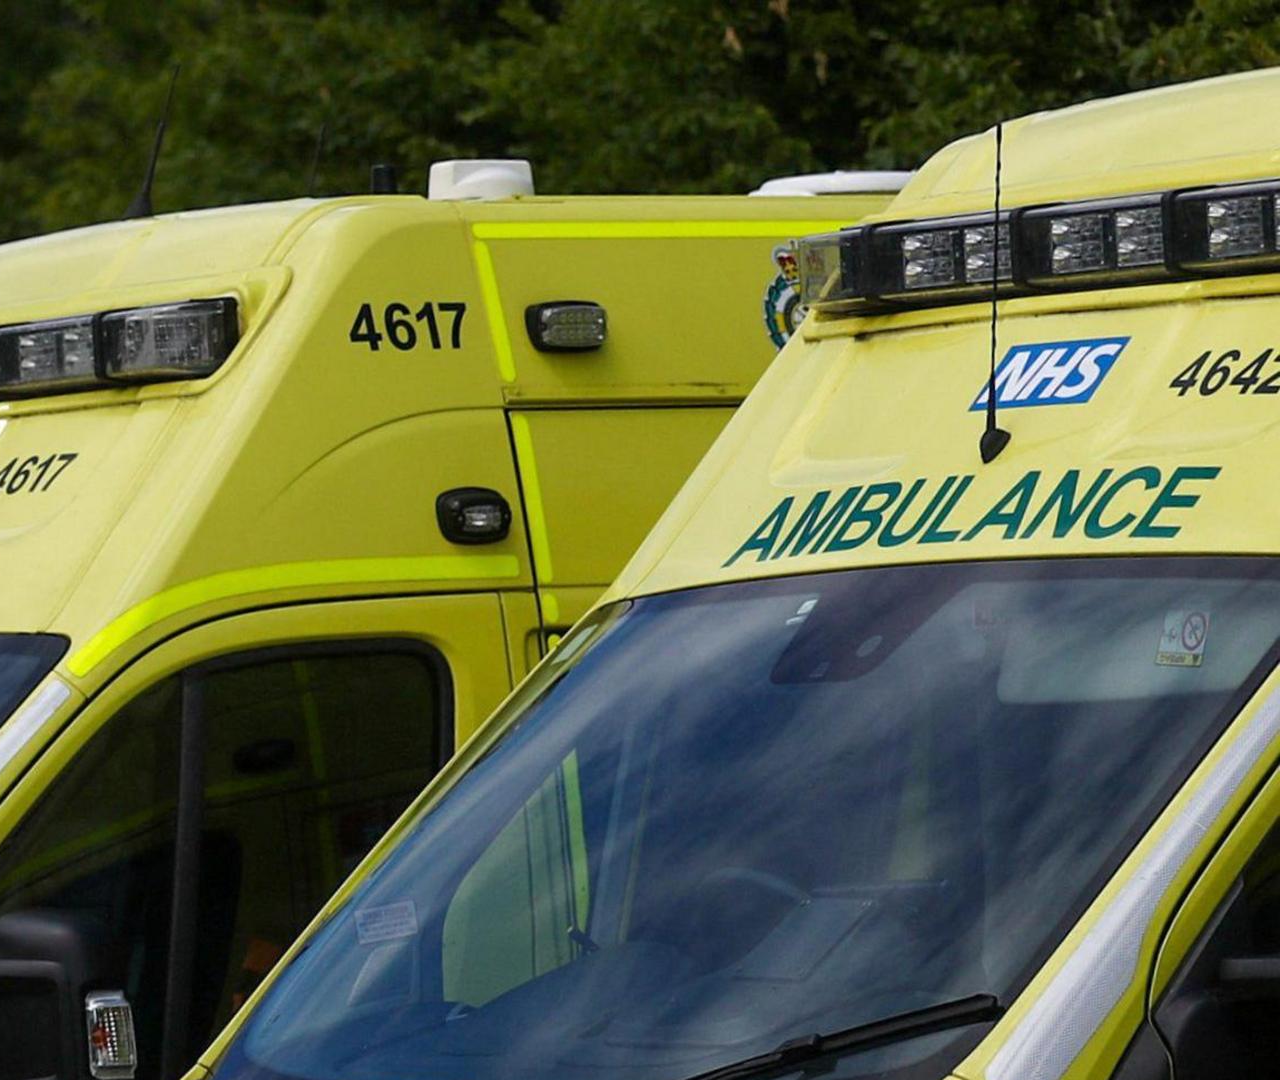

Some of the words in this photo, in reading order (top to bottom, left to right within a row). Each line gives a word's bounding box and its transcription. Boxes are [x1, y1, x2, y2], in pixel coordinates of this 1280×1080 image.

[350, 301, 467, 351] 4617
[977, 343, 1124, 404] NHS
[721, 466, 1222, 568] AMBULANCE
